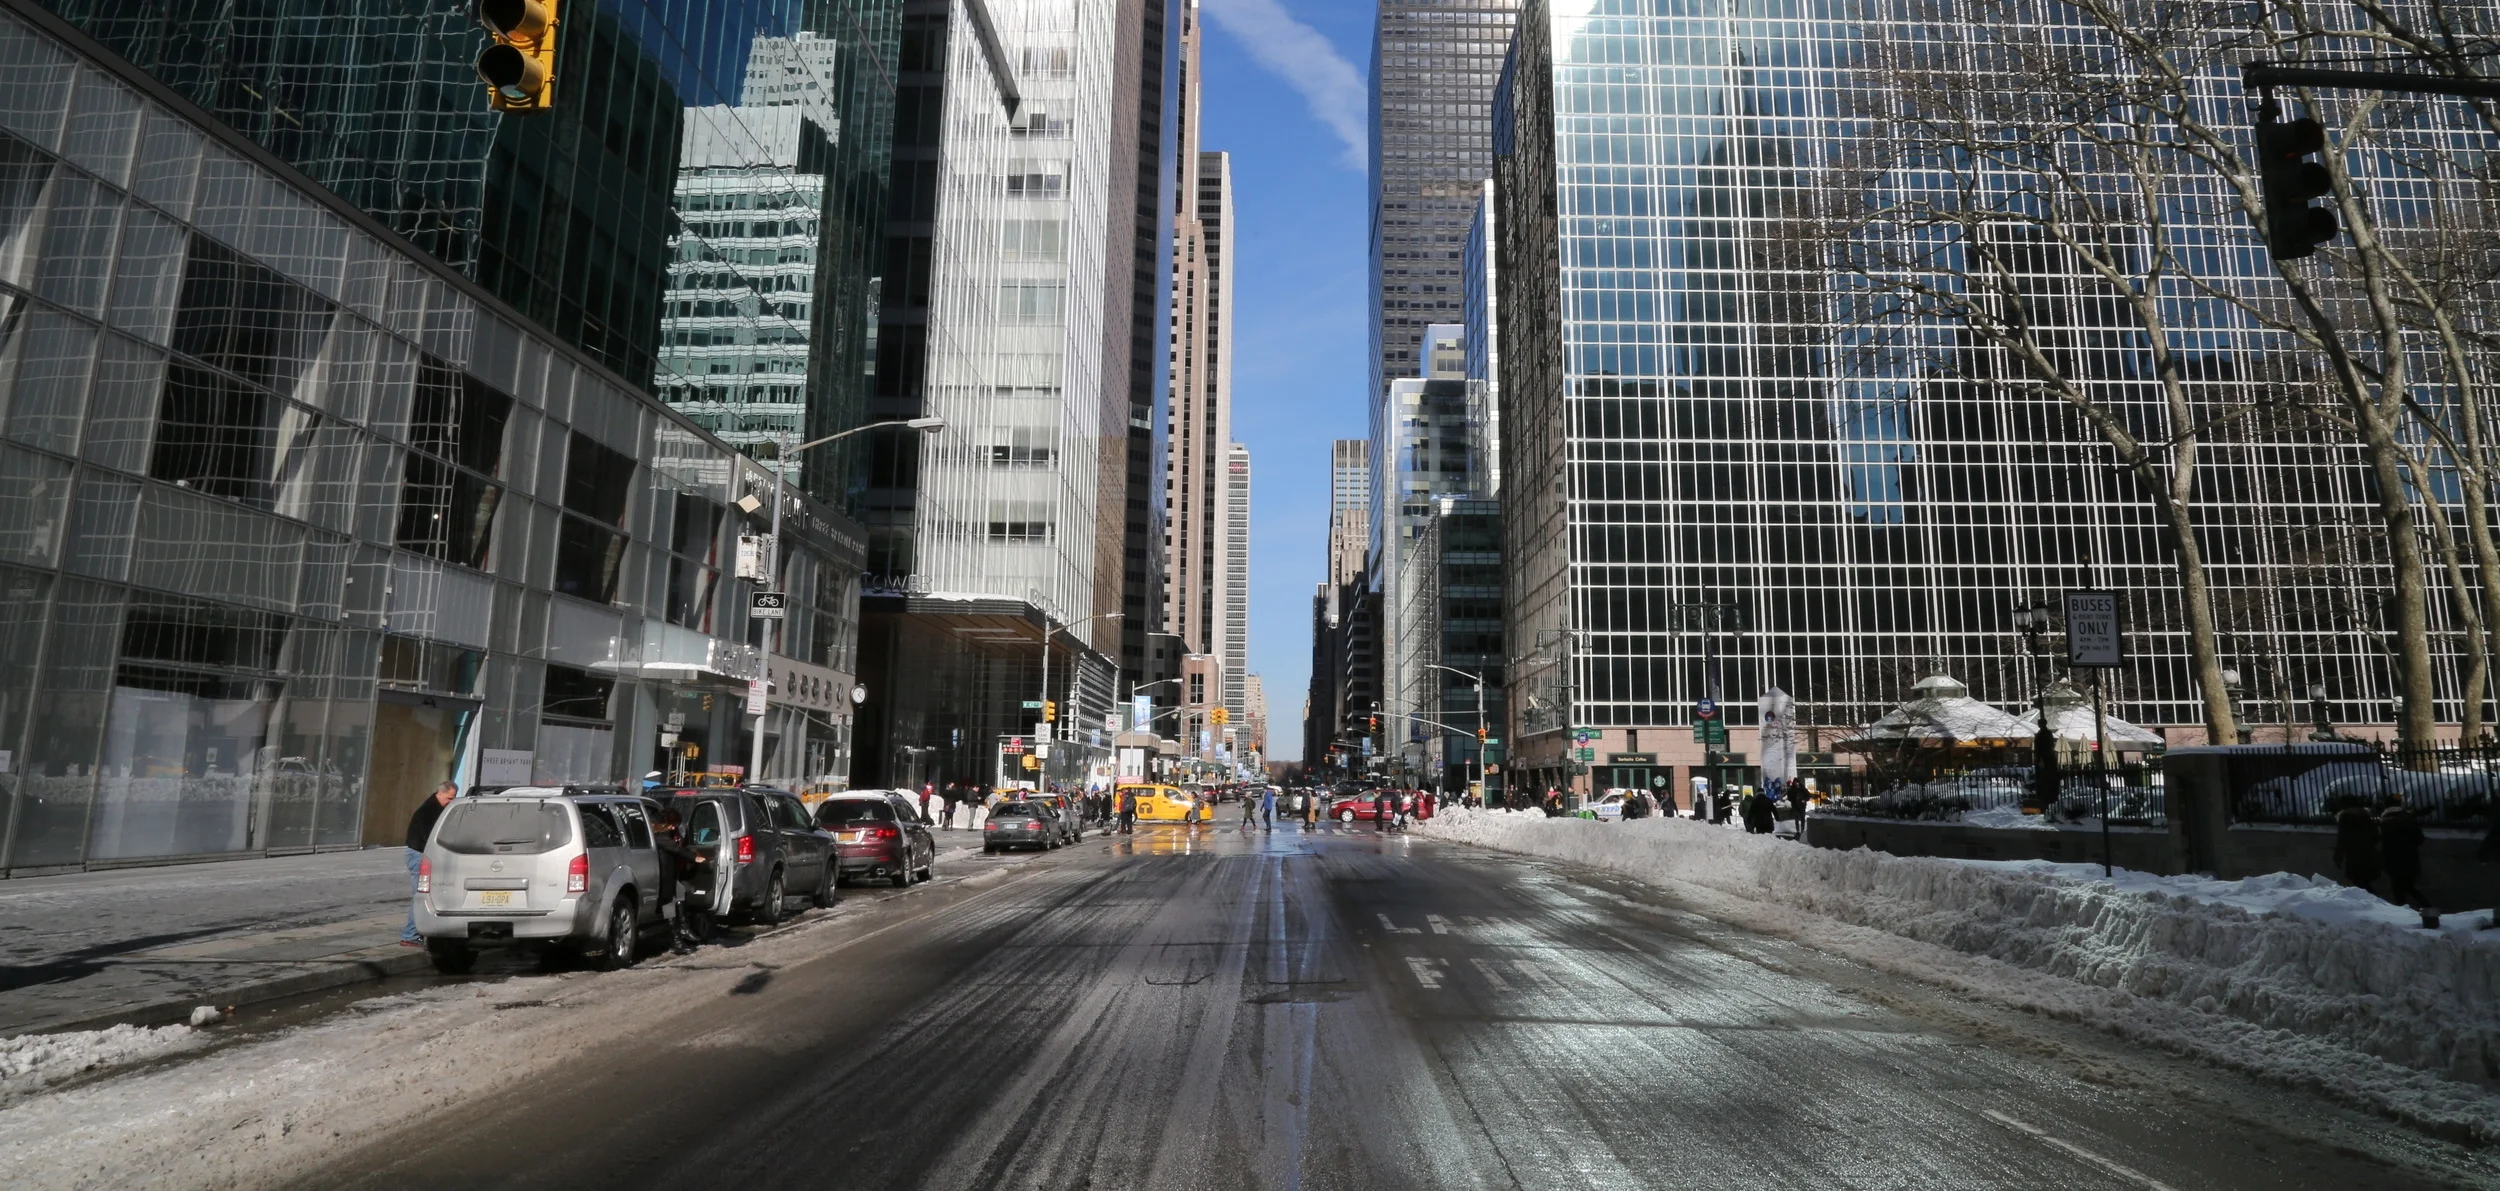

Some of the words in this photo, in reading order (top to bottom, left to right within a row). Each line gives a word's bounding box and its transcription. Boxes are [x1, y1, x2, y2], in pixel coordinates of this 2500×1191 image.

[861, 571, 933, 593] TOWER
[2072, 599, 2112, 612] BUSES
[2078, 622, 2108, 635] ONLY
